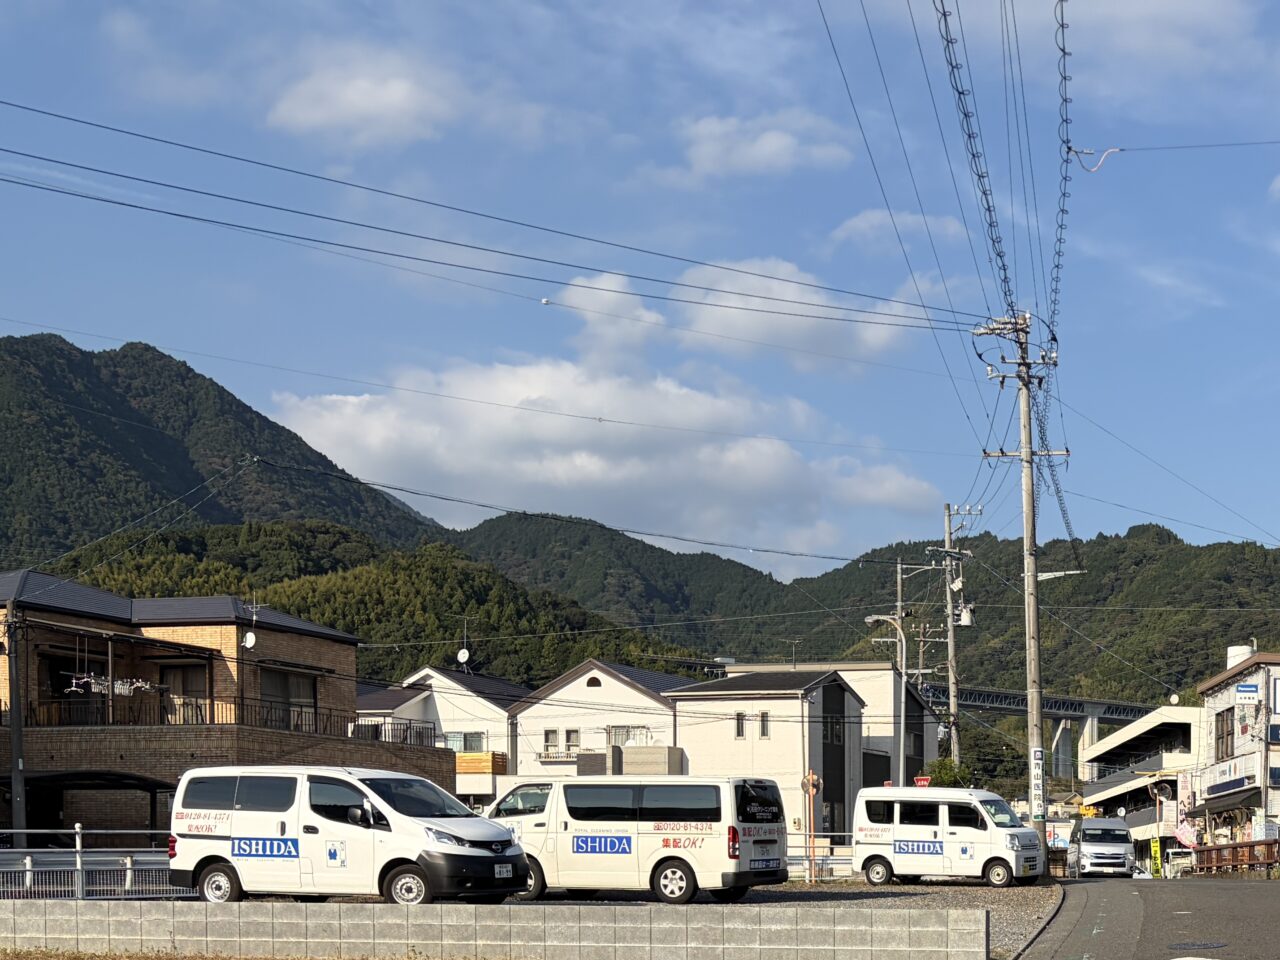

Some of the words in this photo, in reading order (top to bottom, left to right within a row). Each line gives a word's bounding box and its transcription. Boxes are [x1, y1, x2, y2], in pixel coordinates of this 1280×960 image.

[663, 823, 713, 832] 0120-81-4374
[233, 839, 297, 856] ISHIDA
[573, 837, 630, 853] ISHIDA
[661, 837, 705, 849] 集配OK!
[894, 841, 943, 853] ISHIDA
